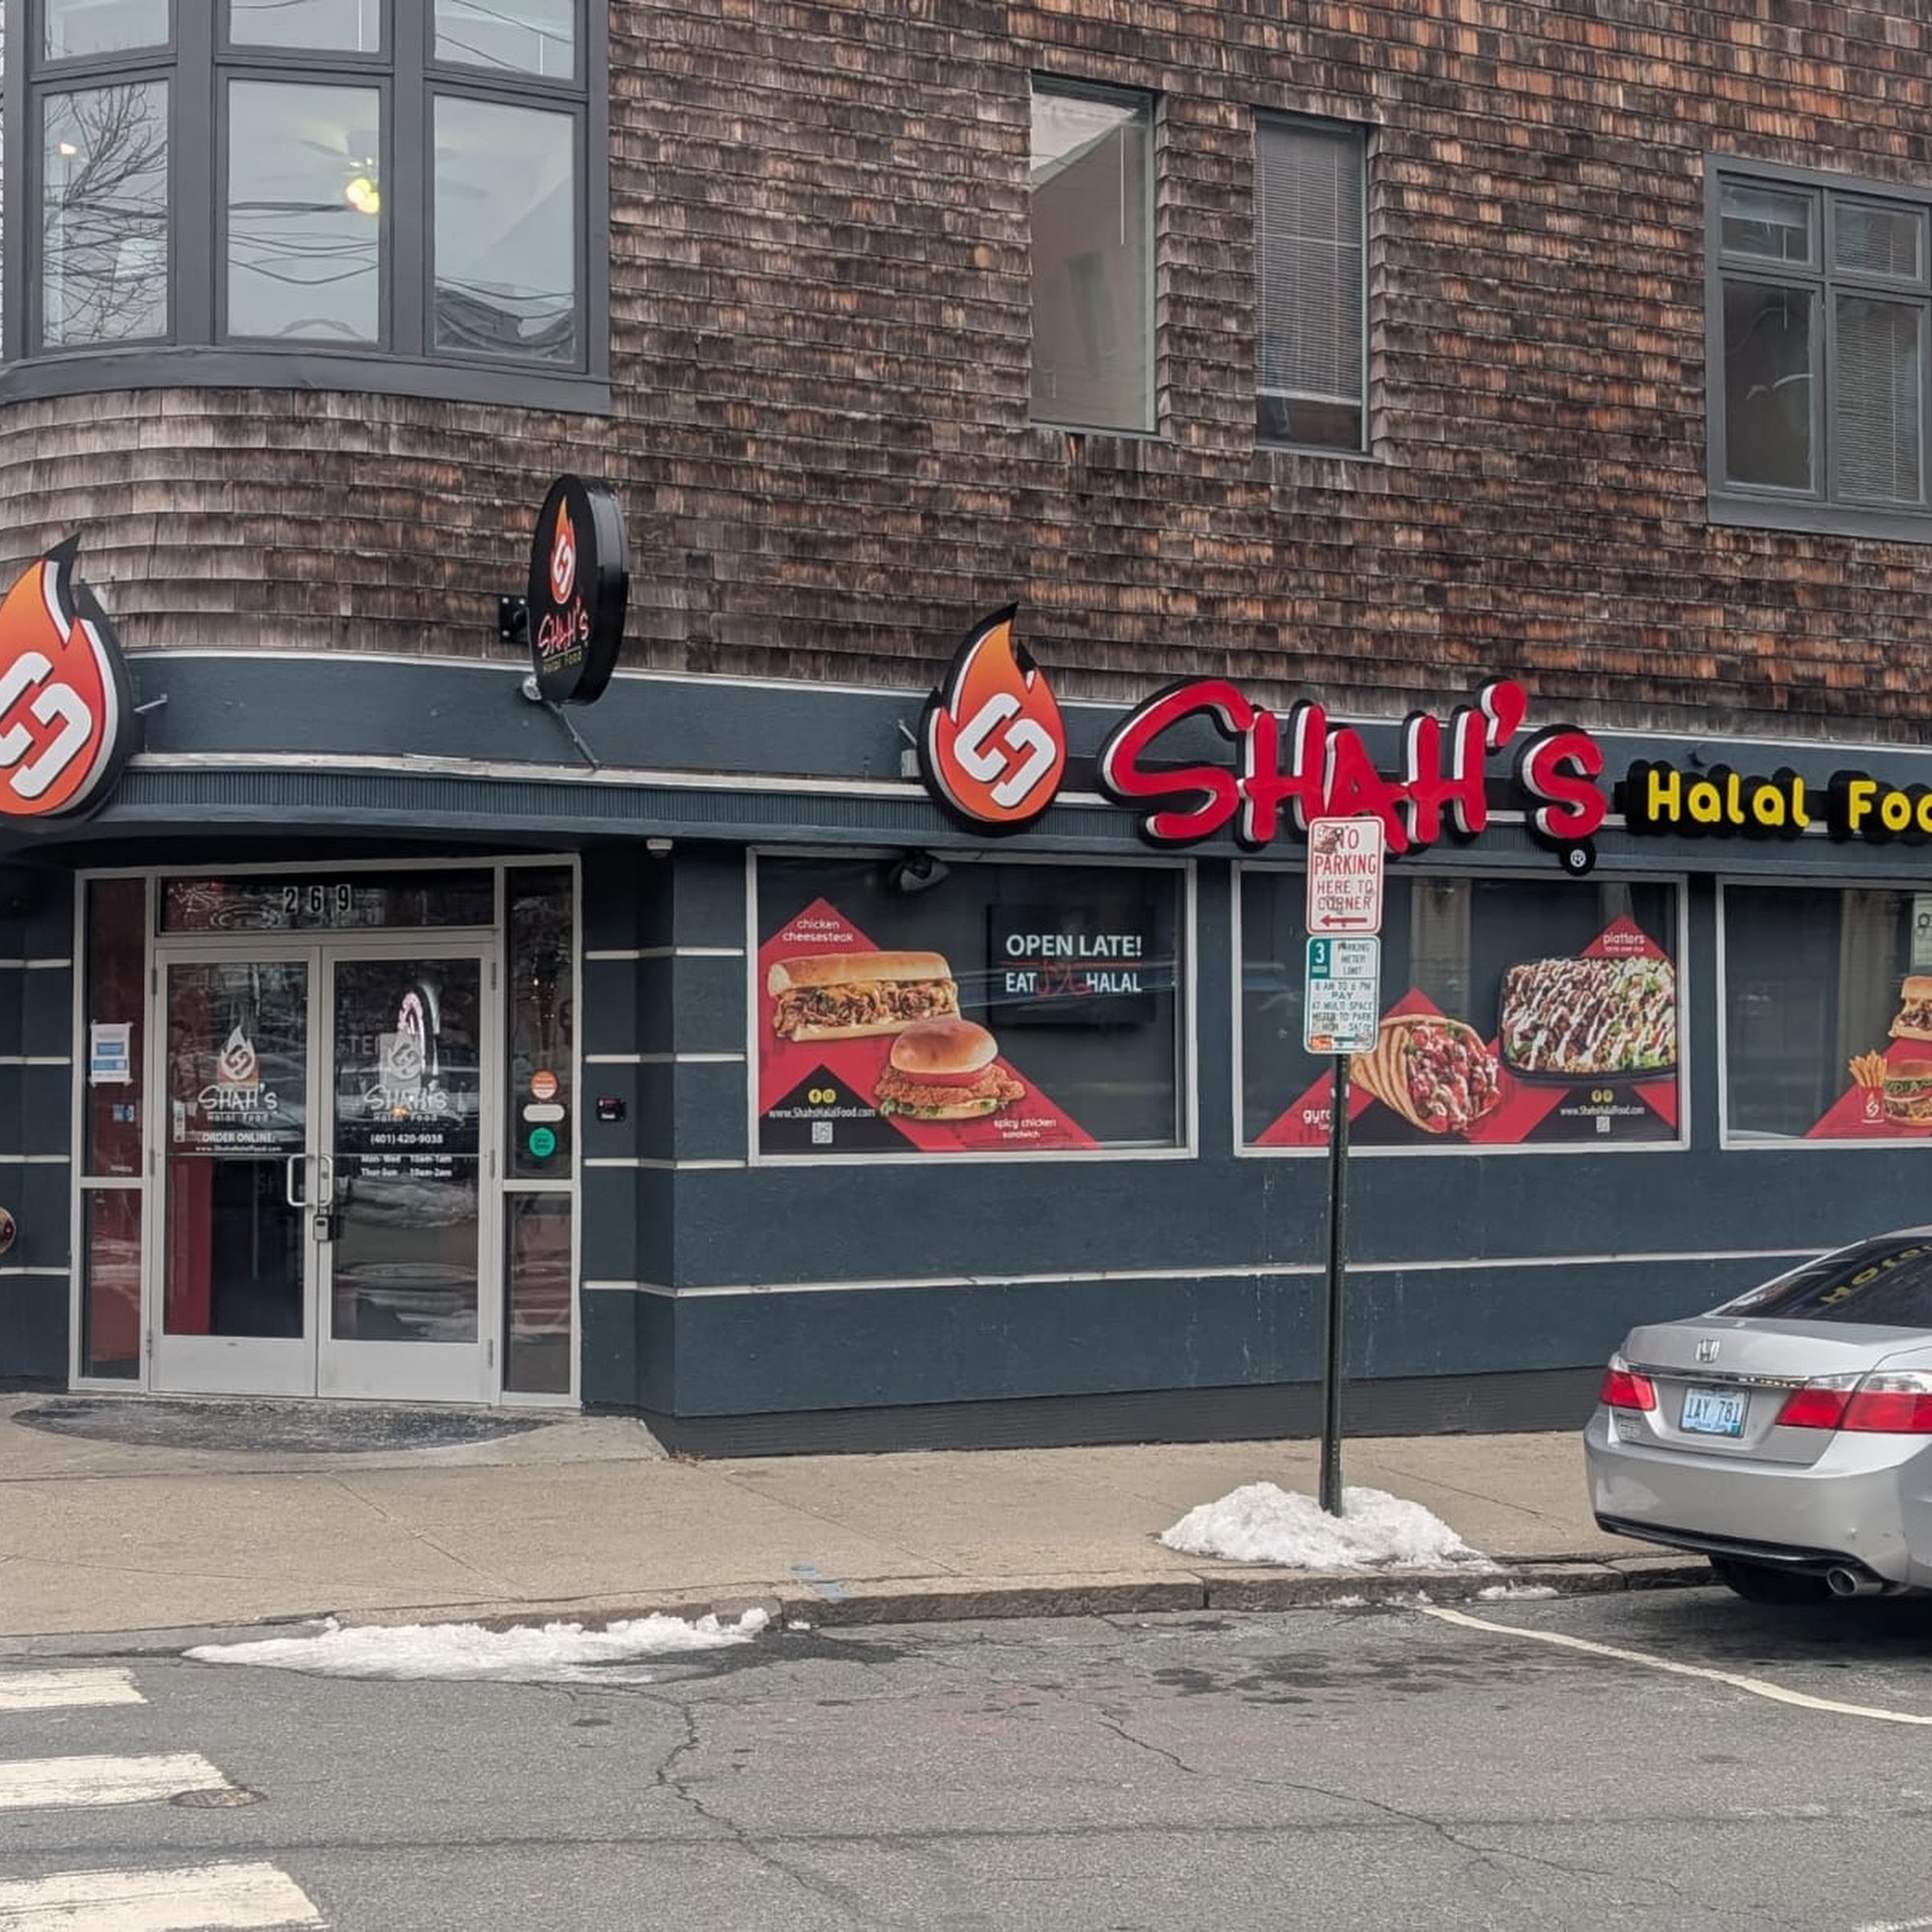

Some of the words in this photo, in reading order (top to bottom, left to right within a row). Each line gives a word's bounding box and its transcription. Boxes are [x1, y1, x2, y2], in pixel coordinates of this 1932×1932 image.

[1102, 679, 1608, 854] SHAH'S
[1648, 770, 1809, 827] Halal
[1314, 854, 1377, 875] PARKING
[1317, 880, 1351, 895] HERE
[1357, 879, 1374, 895] TO
[285, 885, 349, 914] 269
[1318, 896, 1372, 911] CORNER
[797, 919, 839, 929] chicken
[1006, 934, 1073, 956] OPEN
[1079, 935, 1142, 956] LATE!
[1604, 931, 1645, 945] platters
[1315, 942, 1325, 964] 3
[1006, 972, 1037, 993] EAT
[1086, 972, 1142, 993] HALAL
[1350, 1001, 1373, 1010] SPACE
[198, 1083, 278, 1110] SHAH'S
[364, 1079, 448, 1110] SHAH'S
[201, 1132, 235, 1143] ORDER
[370, 1134, 396, 1146] (401)
[1719, 1400, 1741, 1424] 781
